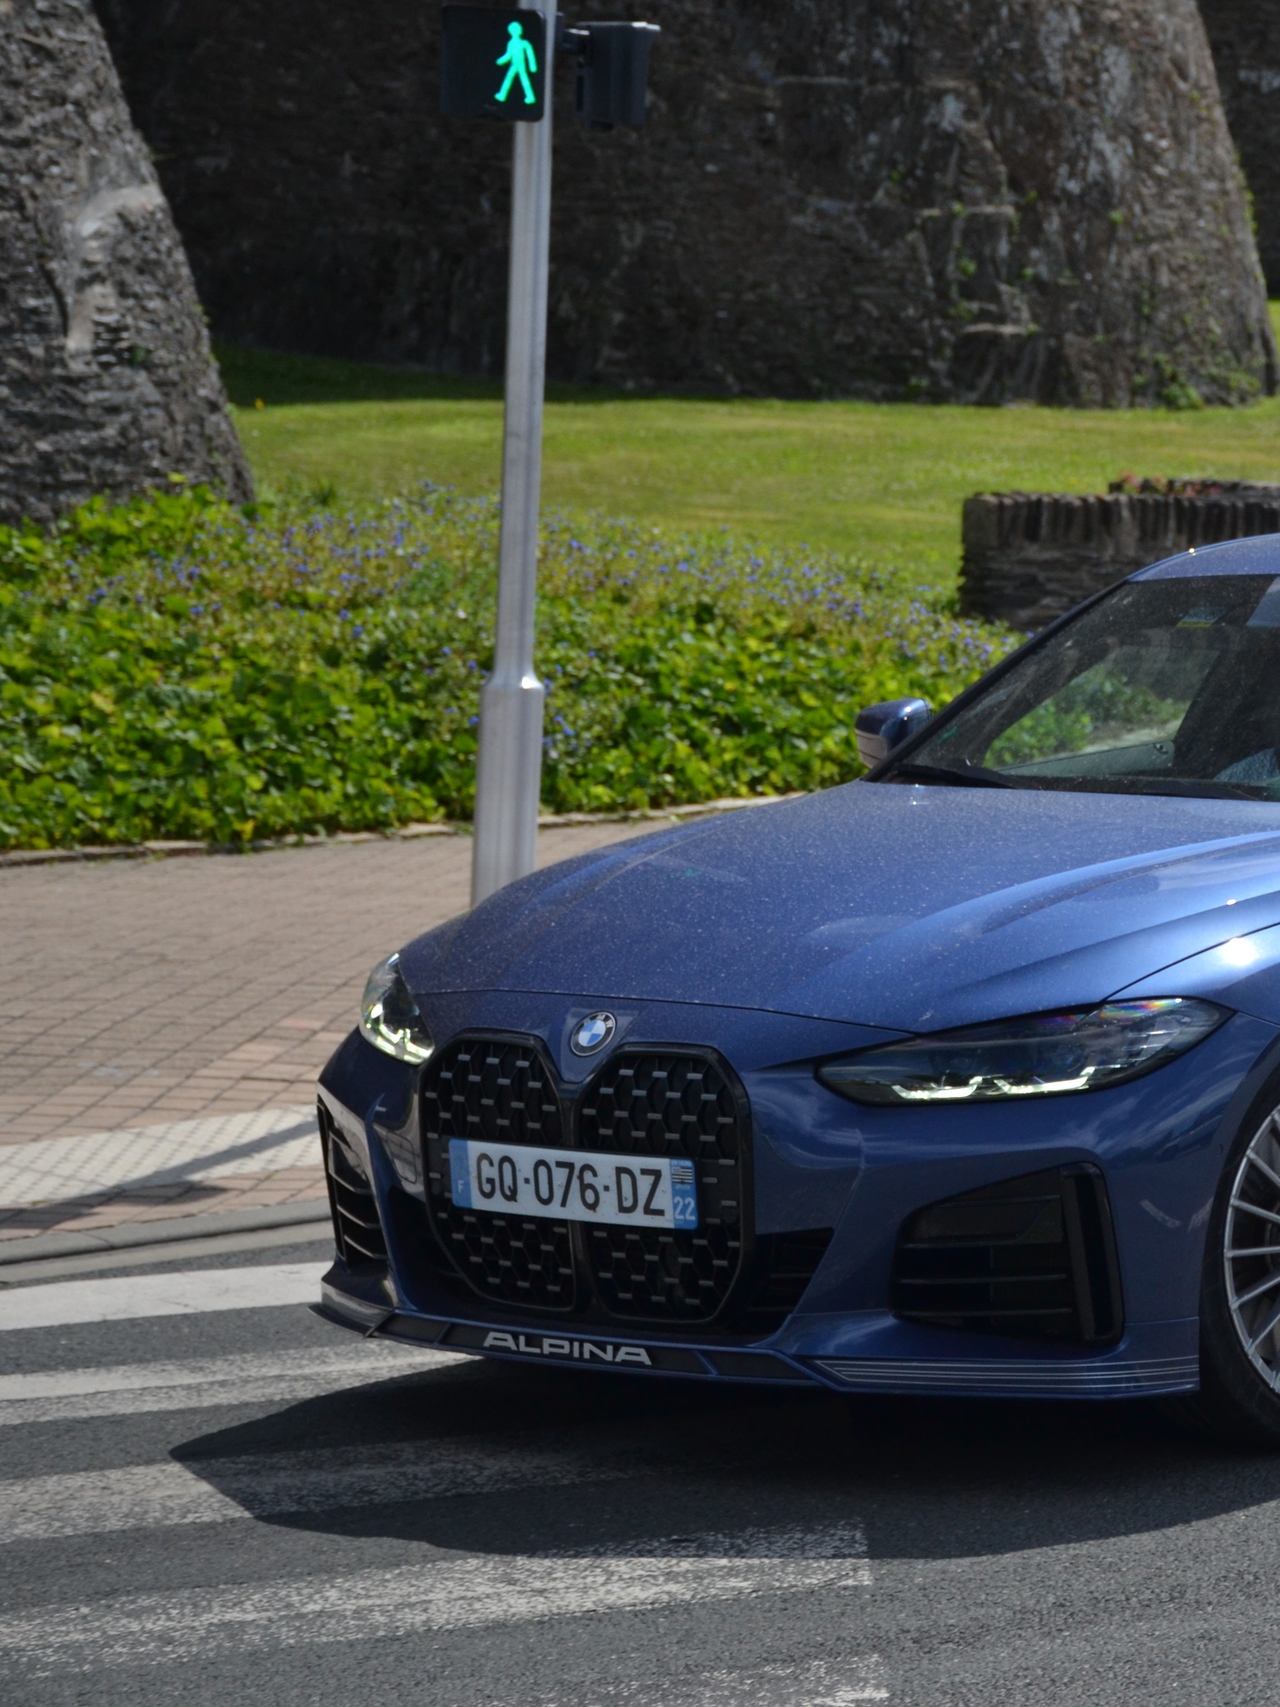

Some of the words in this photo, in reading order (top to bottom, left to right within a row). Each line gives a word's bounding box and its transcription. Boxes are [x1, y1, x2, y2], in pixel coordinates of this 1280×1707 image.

[457, 1180, 465, 1193] F
[476, 1153, 666, 1217] GQ-076-DZ
[673, 1196, 696, 1221] 22
[483, 1331, 652, 1366] ALPINA
